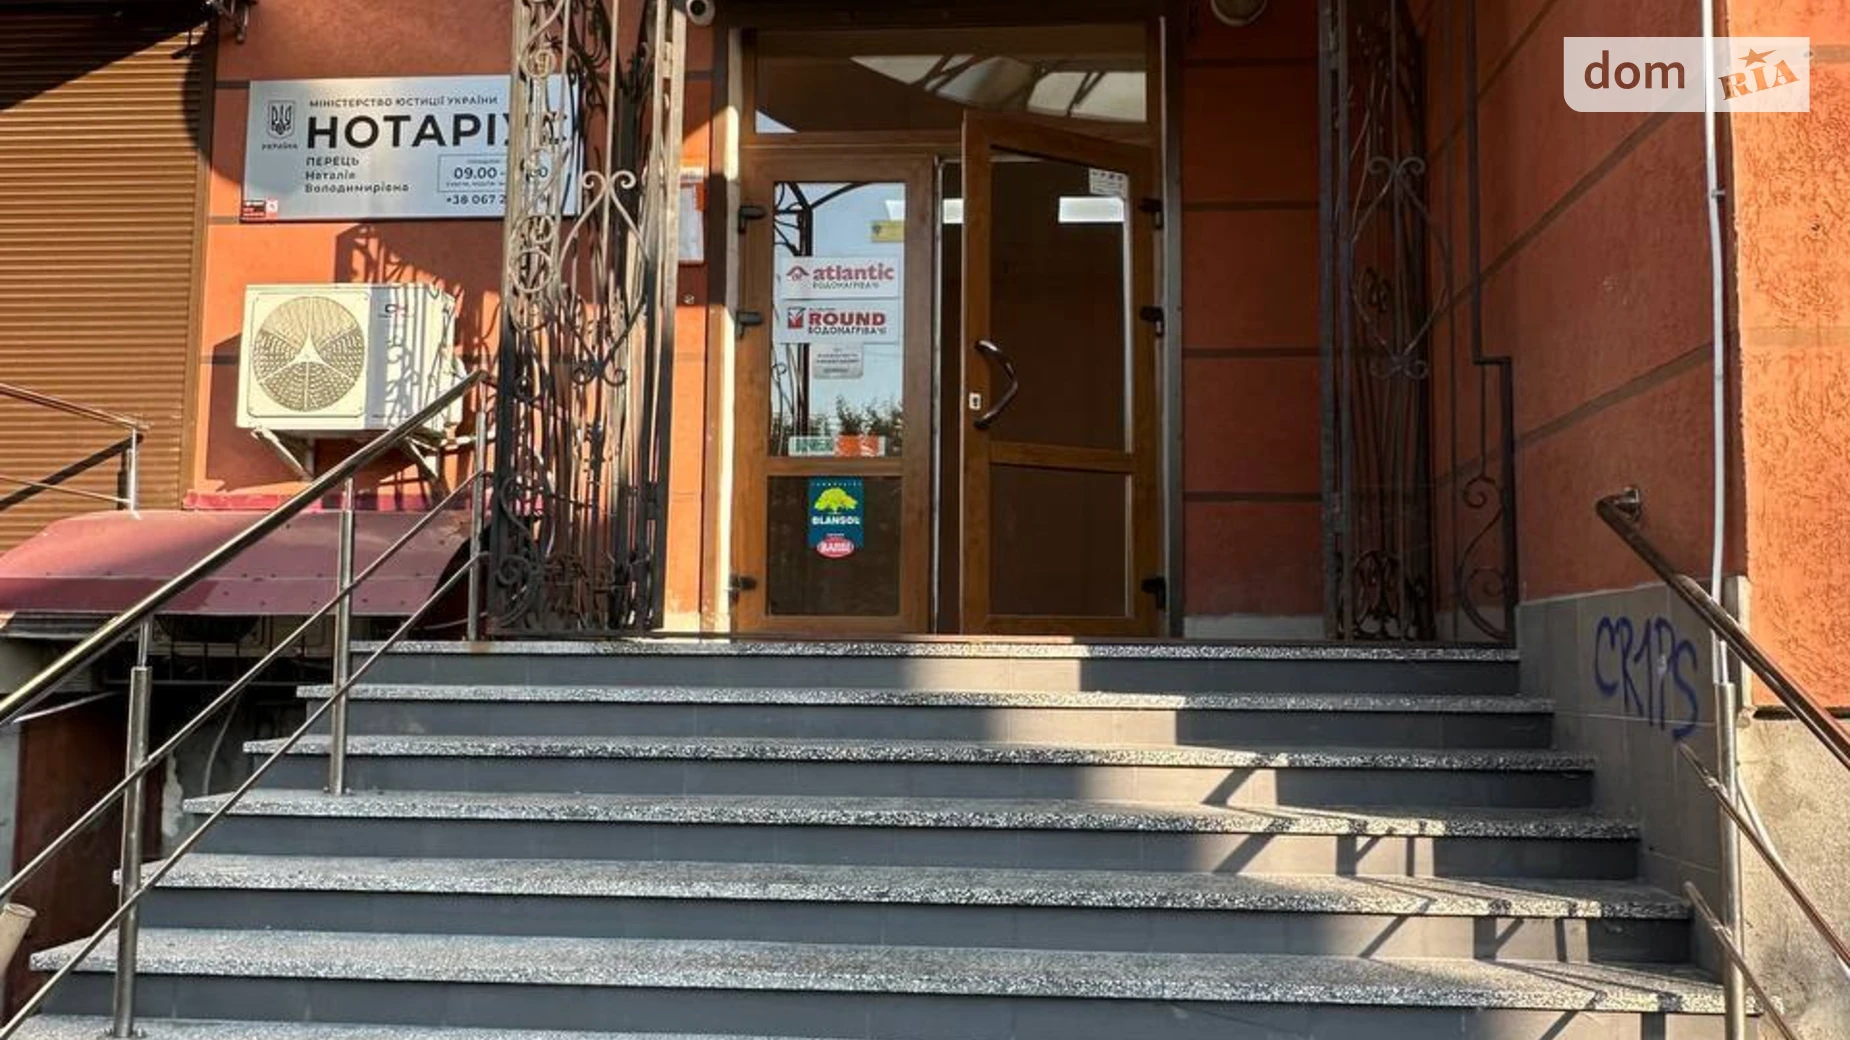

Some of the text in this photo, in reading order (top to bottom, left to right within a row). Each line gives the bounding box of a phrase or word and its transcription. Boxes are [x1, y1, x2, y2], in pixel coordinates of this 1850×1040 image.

[309, 95, 499, 108] МІНІСТЕРСТВО ЮСТИЦІЇ УКРАЇНИ
[306, 156, 359, 167] ПЕРЕЦЬ
[305, 170, 356, 180] Наталія
[454, 167, 498, 180] 09.00
[304, 182, 409, 194] Володимирівна
[446, 194, 469, 205] +38
[471, 194, 496, 204] 067
[813, 262, 895, 281] atlantic
[808, 311, 886, 326] ROUND
